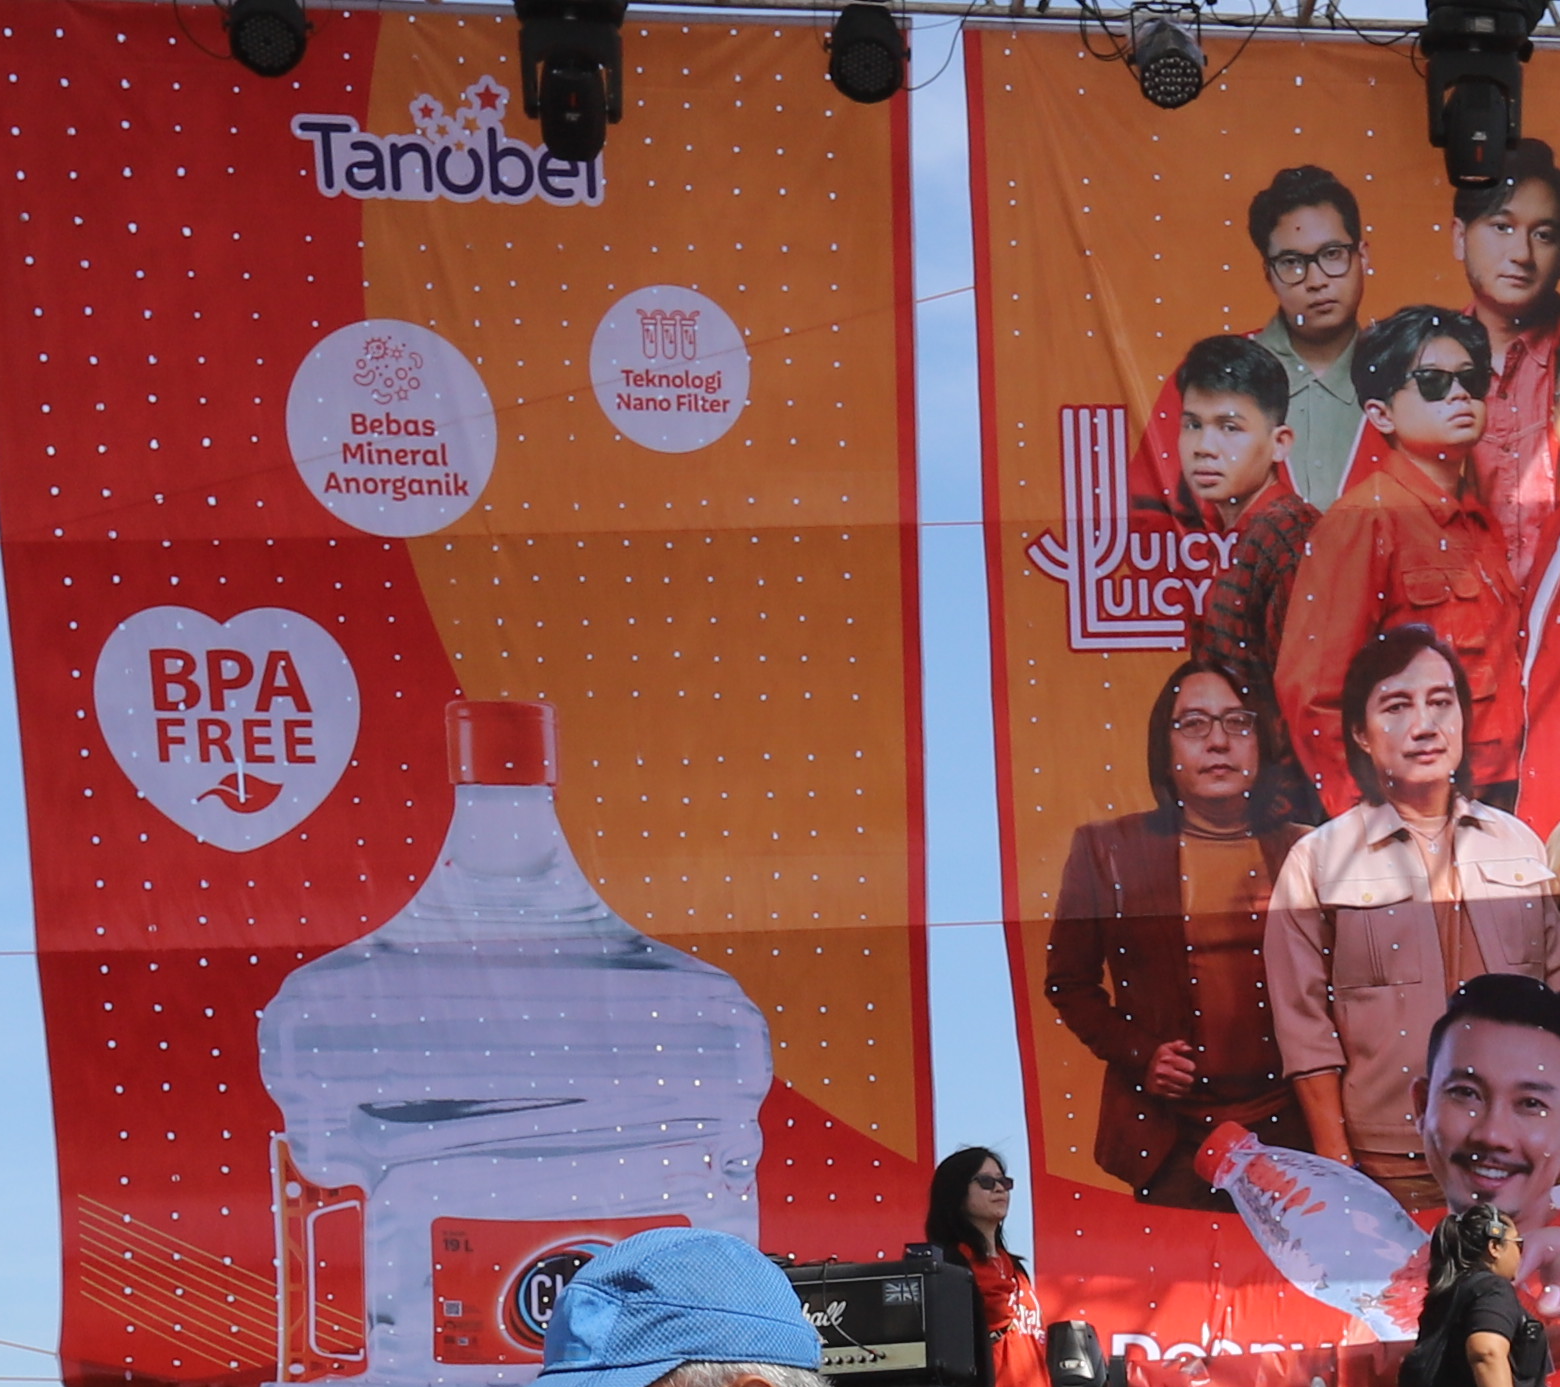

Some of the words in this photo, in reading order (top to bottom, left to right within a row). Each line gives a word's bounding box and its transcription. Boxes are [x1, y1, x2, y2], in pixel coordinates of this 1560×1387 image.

[621, 369, 723, 393] Teknologi
[616, 393, 672, 412] Nano
[676, 395, 731, 414] Filter
[350, 412, 436, 438] Bebas
[342, 443, 449, 467] Mineral
[324, 472, 470, 502] Anorganik
[148, 647, 313, 713] BPA
[155, 717, 317, 764] FREE
[530, 1272, 565, 1323] Cl
[802, 1300, 848, 1328] hall
